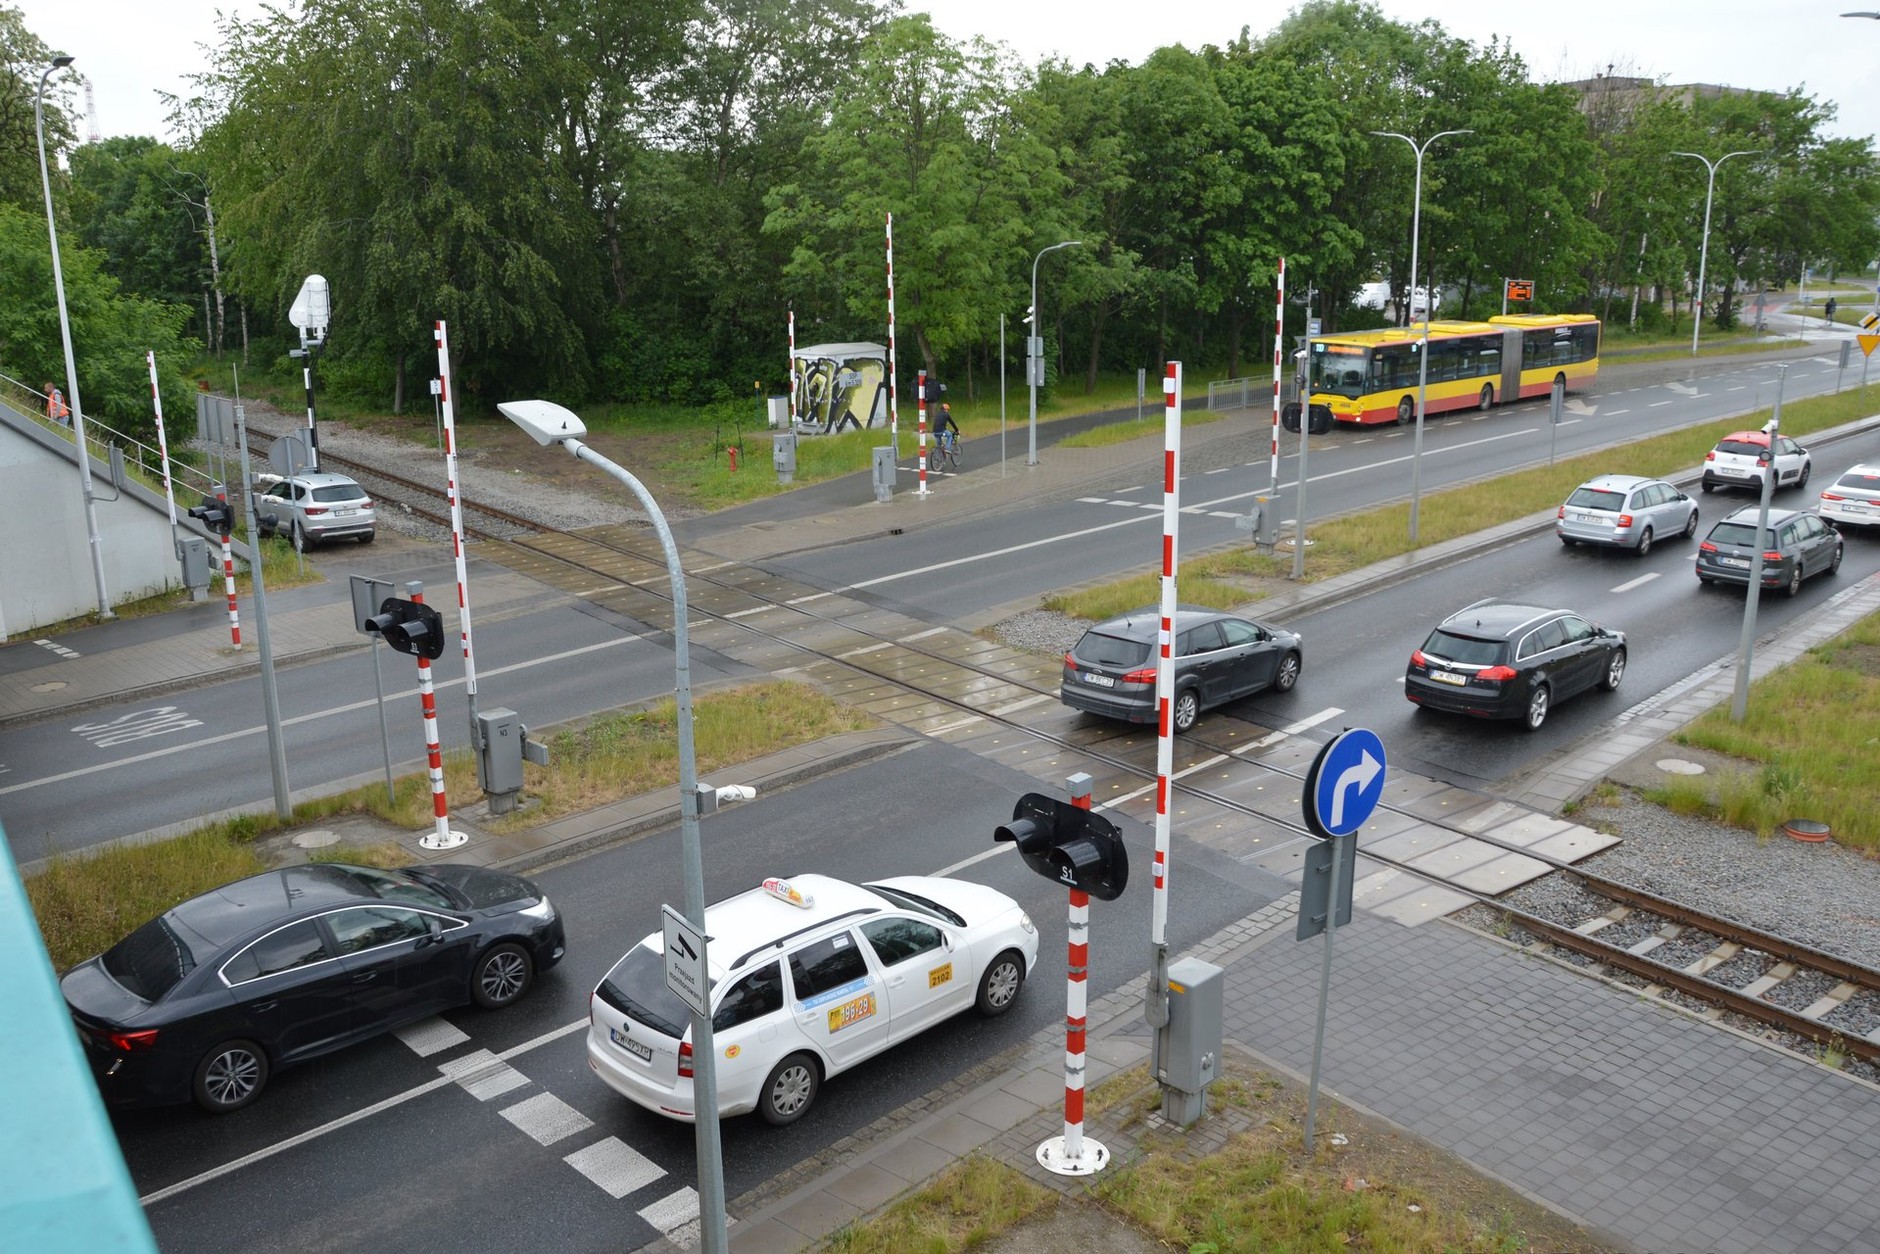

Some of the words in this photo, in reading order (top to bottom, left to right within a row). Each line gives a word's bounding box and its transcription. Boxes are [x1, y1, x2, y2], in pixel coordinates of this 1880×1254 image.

[1061, 865, 1073, 880] S1
[778, 883, 790, 894] TAXI
[674, 962, 695, 985] Przejazd
[932, 972, 950, 986] 2102
[668, 971, 703, 1005] monitorowany
